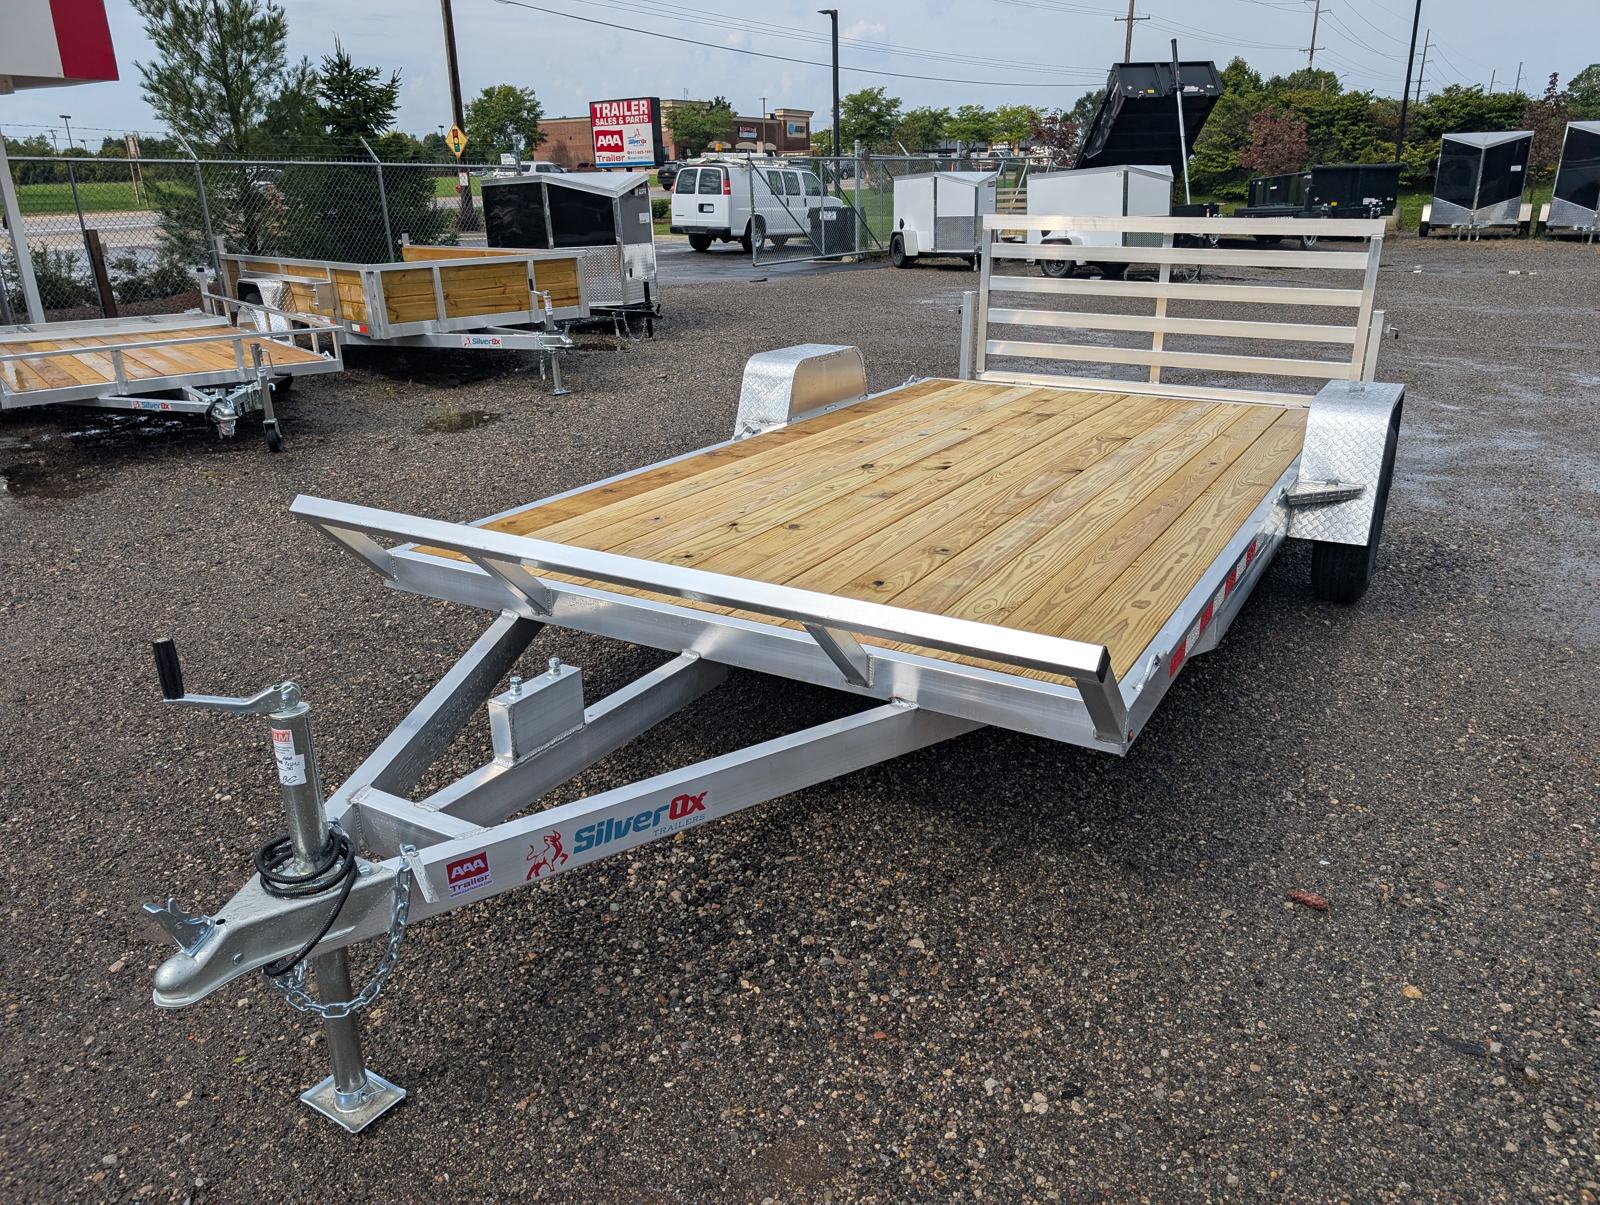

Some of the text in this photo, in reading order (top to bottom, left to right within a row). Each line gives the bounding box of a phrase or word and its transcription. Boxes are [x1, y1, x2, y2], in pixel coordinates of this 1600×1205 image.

[594, 100, 648, 118] TRAILER
[595, 115, 648, 126] SALES & PARTS
[597, 135, 622, 147] AAA
[596, 154, 626, 162] Trailer
[653, 813, 706, 837] TRAILERS
[451, 858, 486, 879] AAA
[449, 873, 490, 892] Trailer
